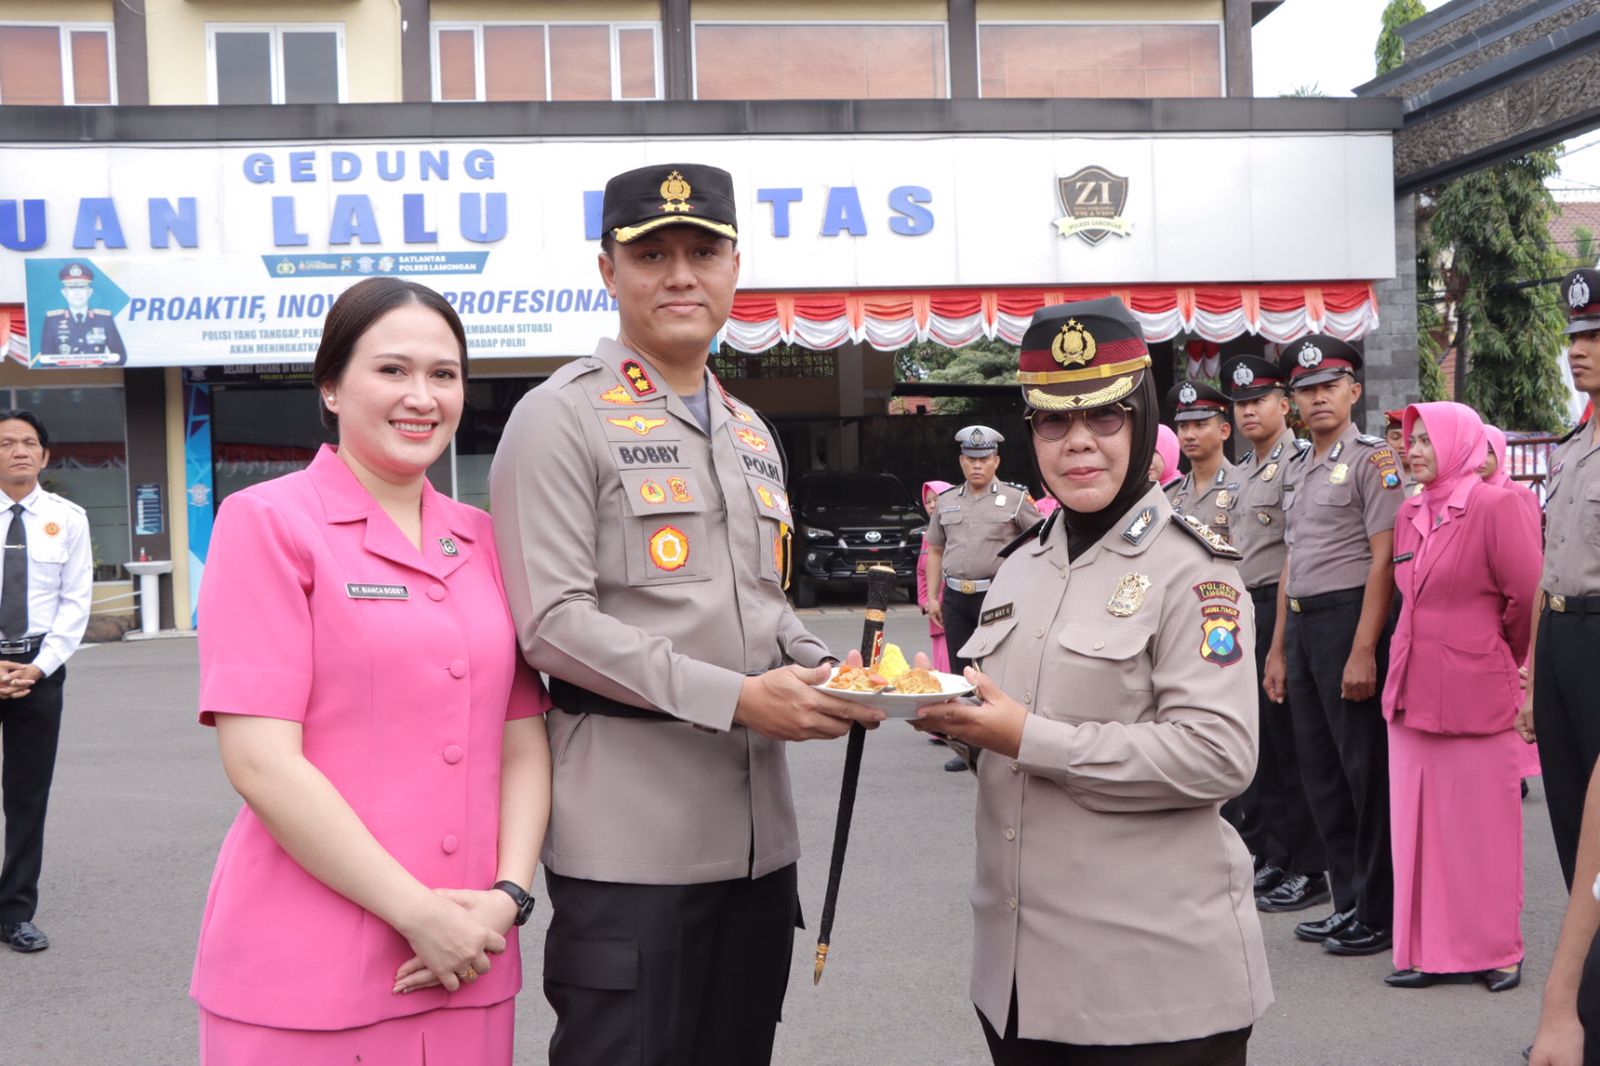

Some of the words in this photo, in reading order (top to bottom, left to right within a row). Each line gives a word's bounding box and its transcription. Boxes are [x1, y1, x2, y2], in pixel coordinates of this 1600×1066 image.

[243, 149, 495, 184] GEDUNG
[1075, 181, 1112, 205] ZI
[271, 192, 508, 247] LALU
[399, 255, 446, 263] SATLANTAS
[429, 263, 476, 271] LAMONGAN
[128, 294, 266, 323] PROAKTIF,
[202, 330, 231, 340] POLISI
[233, 330, 257, 340] YANG
[517, 323, 552, 333] SITUASI
[230, 344, 254, 354] AKAN
[500, 338, 526, 347] POLRI
[618, 445, 681, 465] BOBBY
[742, 454, 781, 483] POLRI
[1199, 582, 1237, 597] POLRES
